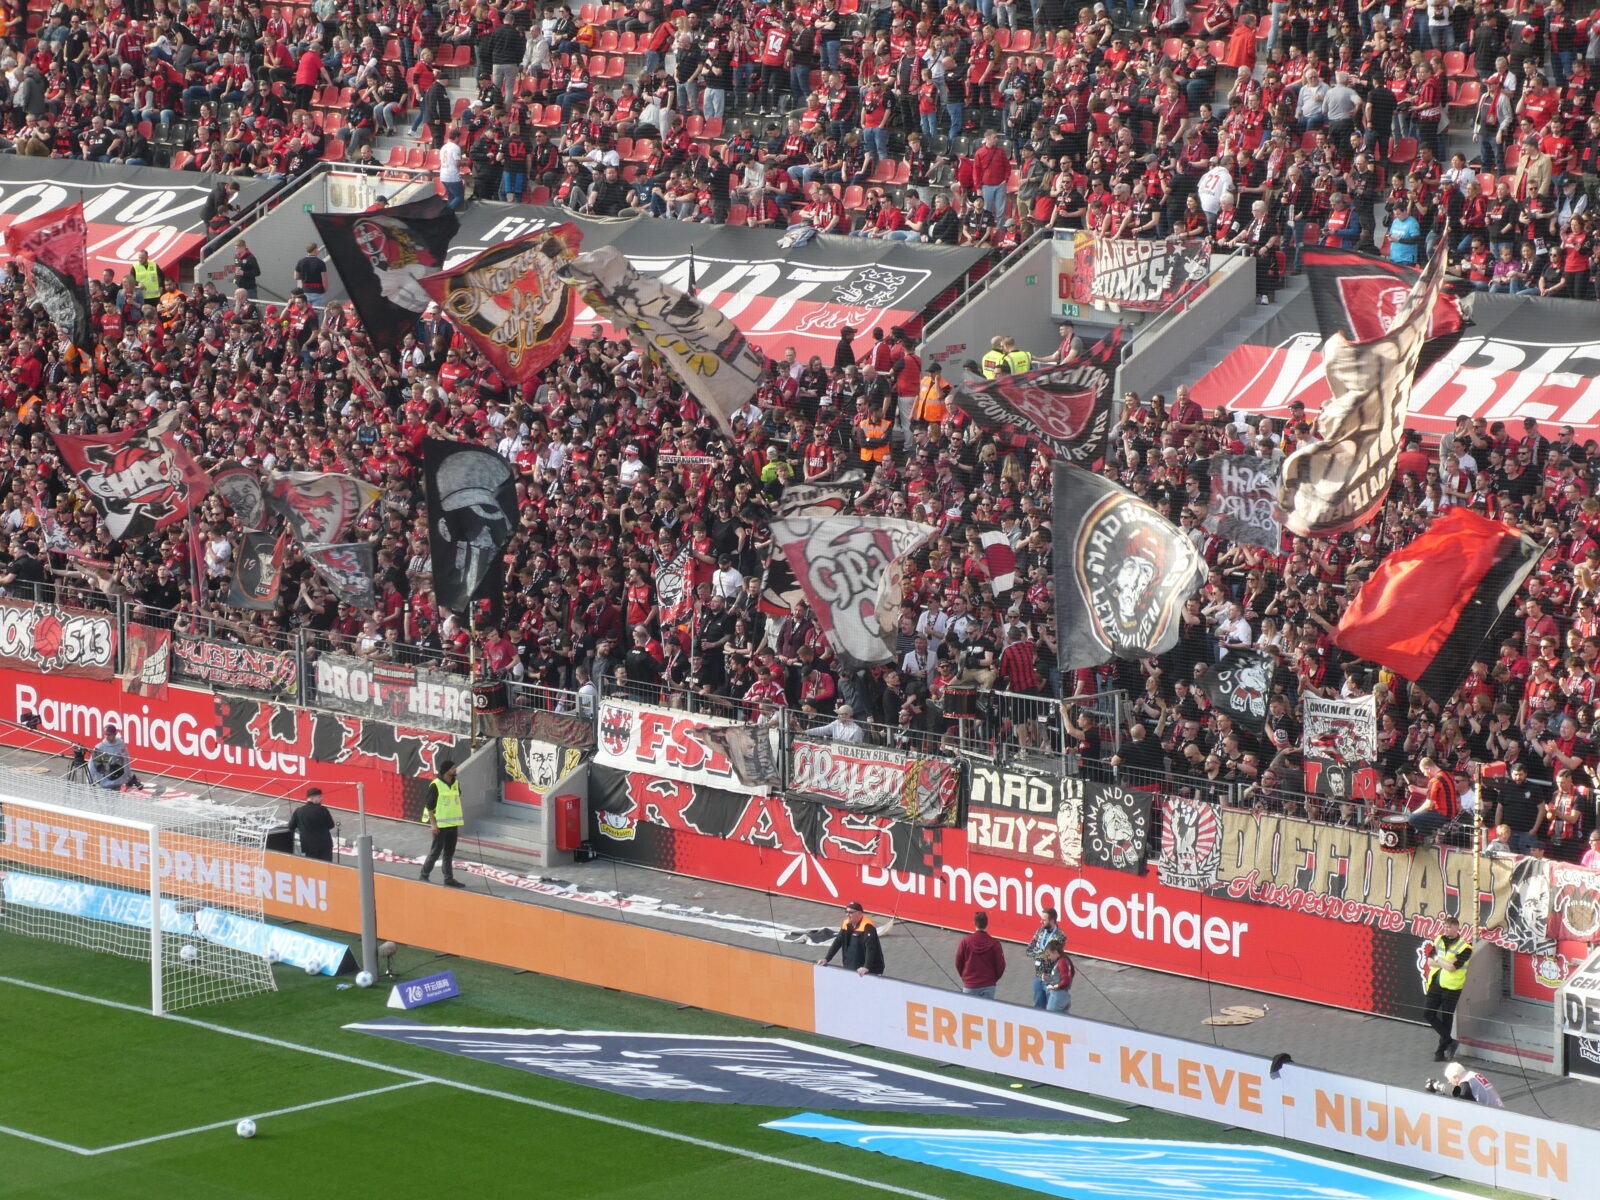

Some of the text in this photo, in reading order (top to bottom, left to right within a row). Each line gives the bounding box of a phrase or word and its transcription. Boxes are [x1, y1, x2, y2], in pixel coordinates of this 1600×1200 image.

[768, 34, 784, 53] 14
[508, 141, 527, 156] 04
[1204, 174, 1221, 190] 27
[63, 615, 112, 668] 513
[173, 638, 279, 679] JUGEND
[1309, 699, 1350, 716] ORIGINAL
[837, 745, 872, 761] GRAFEN
[970, 767, 1054, 812] MAD
[967, 811, 1058, 859] BOYZ
[1086, 786, 1146, 862] COMMANDO 1989
[2, 813, 329, 912] JETZT INFORMIEREN!
[1226, 868, 1404, 932] Ausgesperrte
[268, 928, 341, 966] NIEDAX
[906, 1000, 1072, 1070] ERFURT
[1119, 1045, 1263, 1115] KLEVE
[1314, 1088, 1569, 1183] NIJMEGEN
